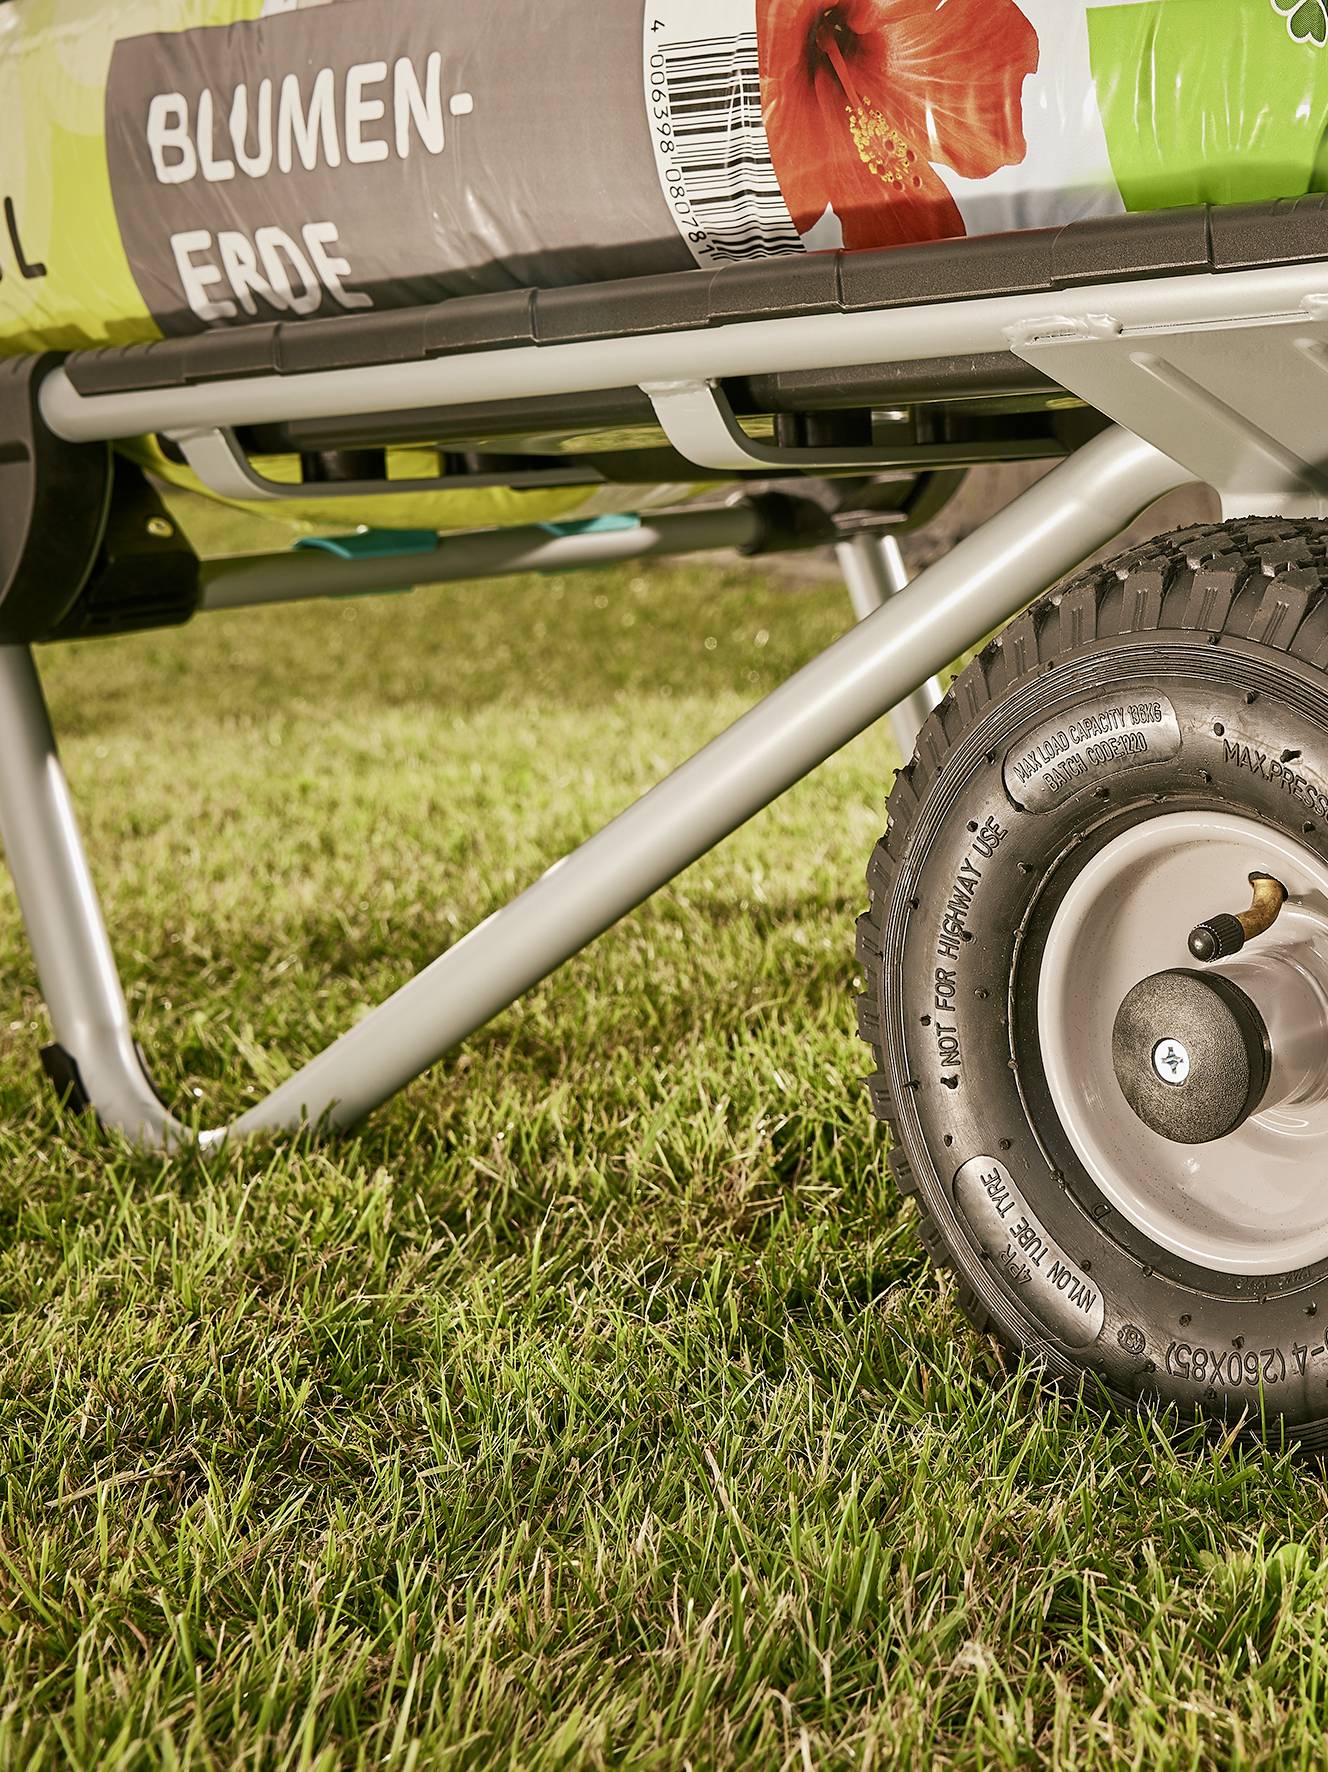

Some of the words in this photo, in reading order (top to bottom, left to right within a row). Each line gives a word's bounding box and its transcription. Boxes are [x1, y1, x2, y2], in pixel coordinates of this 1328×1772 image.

[650, 19, 665, 33] 4
[147, 51, 474, 184] BLUMEN-
[650, 54, 675, 153] 006398
[665, 168, 716, 254] 080781
[170, 221, 374, 321] ERDE
[1013, 751, 1043, 783] MAX
[1037, 730, 1070, 764] LOAD
[1068, 707, 1126, 745] CAPACITY
[1042, 752, 1089, 793] BATCH
[972, 815, 1009, 859] USE
[937, 858, 982, 960] HIGHWAY
[935, 967, 957, 1012] FOR
[935, 1021, 961, 1068] NOT
[979, 1167, 1016, 1219] TYRE
[1000, 1243, 1034, 1285] 4PR
[1009, 1216, 1049, 1268] TUBE
[1046, 1260, 1097, 1314] NYLON
